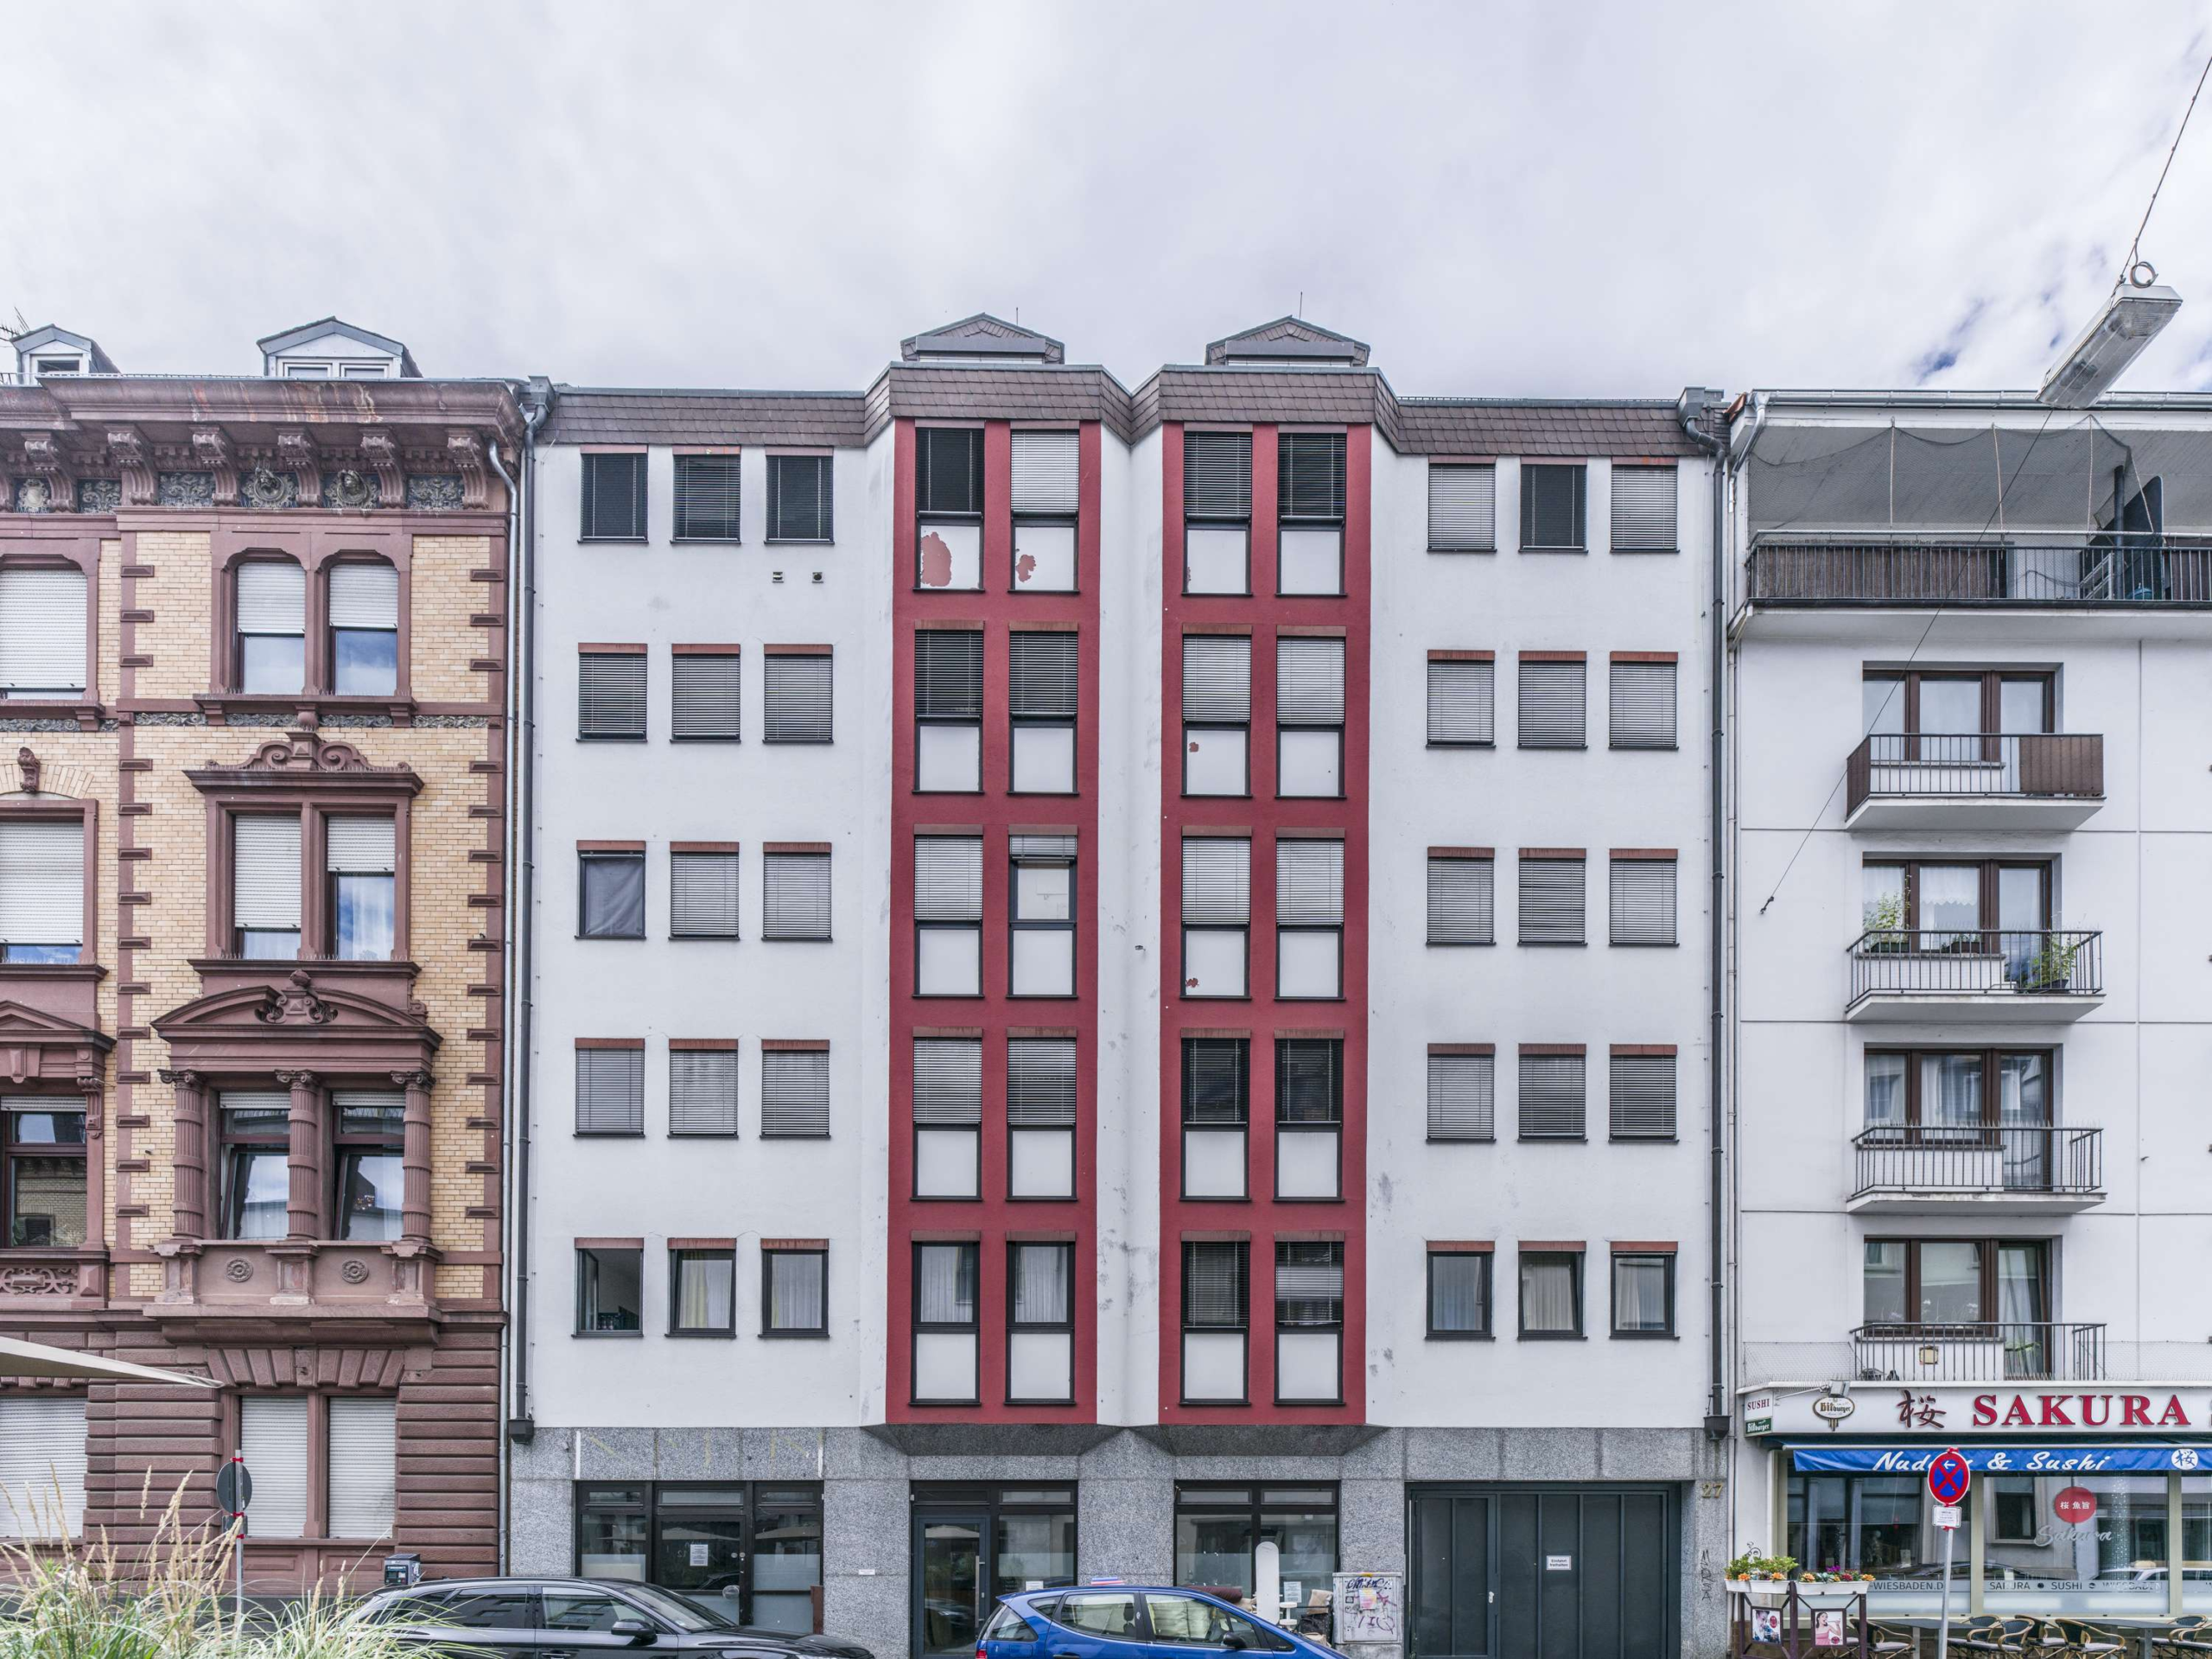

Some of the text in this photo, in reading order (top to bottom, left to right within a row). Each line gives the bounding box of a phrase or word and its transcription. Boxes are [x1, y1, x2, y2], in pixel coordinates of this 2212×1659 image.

[1747, 1398, 1770, 1411] SUSHI
[1819, 1402, 1851, 1413] Bitburger
[1897, 1389, 1947, 1428] 桜
[1973, 1394, 2191, 1426] SAKURA
[1747, 1421, 1770, 1433] Bitburger
[1872, 1451, 2112, 1471] Nud & Sushi
[2174, 1450, 2196, 1466] 桜
[1701, 1483, 1724, 1499] 27
[2050, 1581, 2082, 1590] SUSHI
